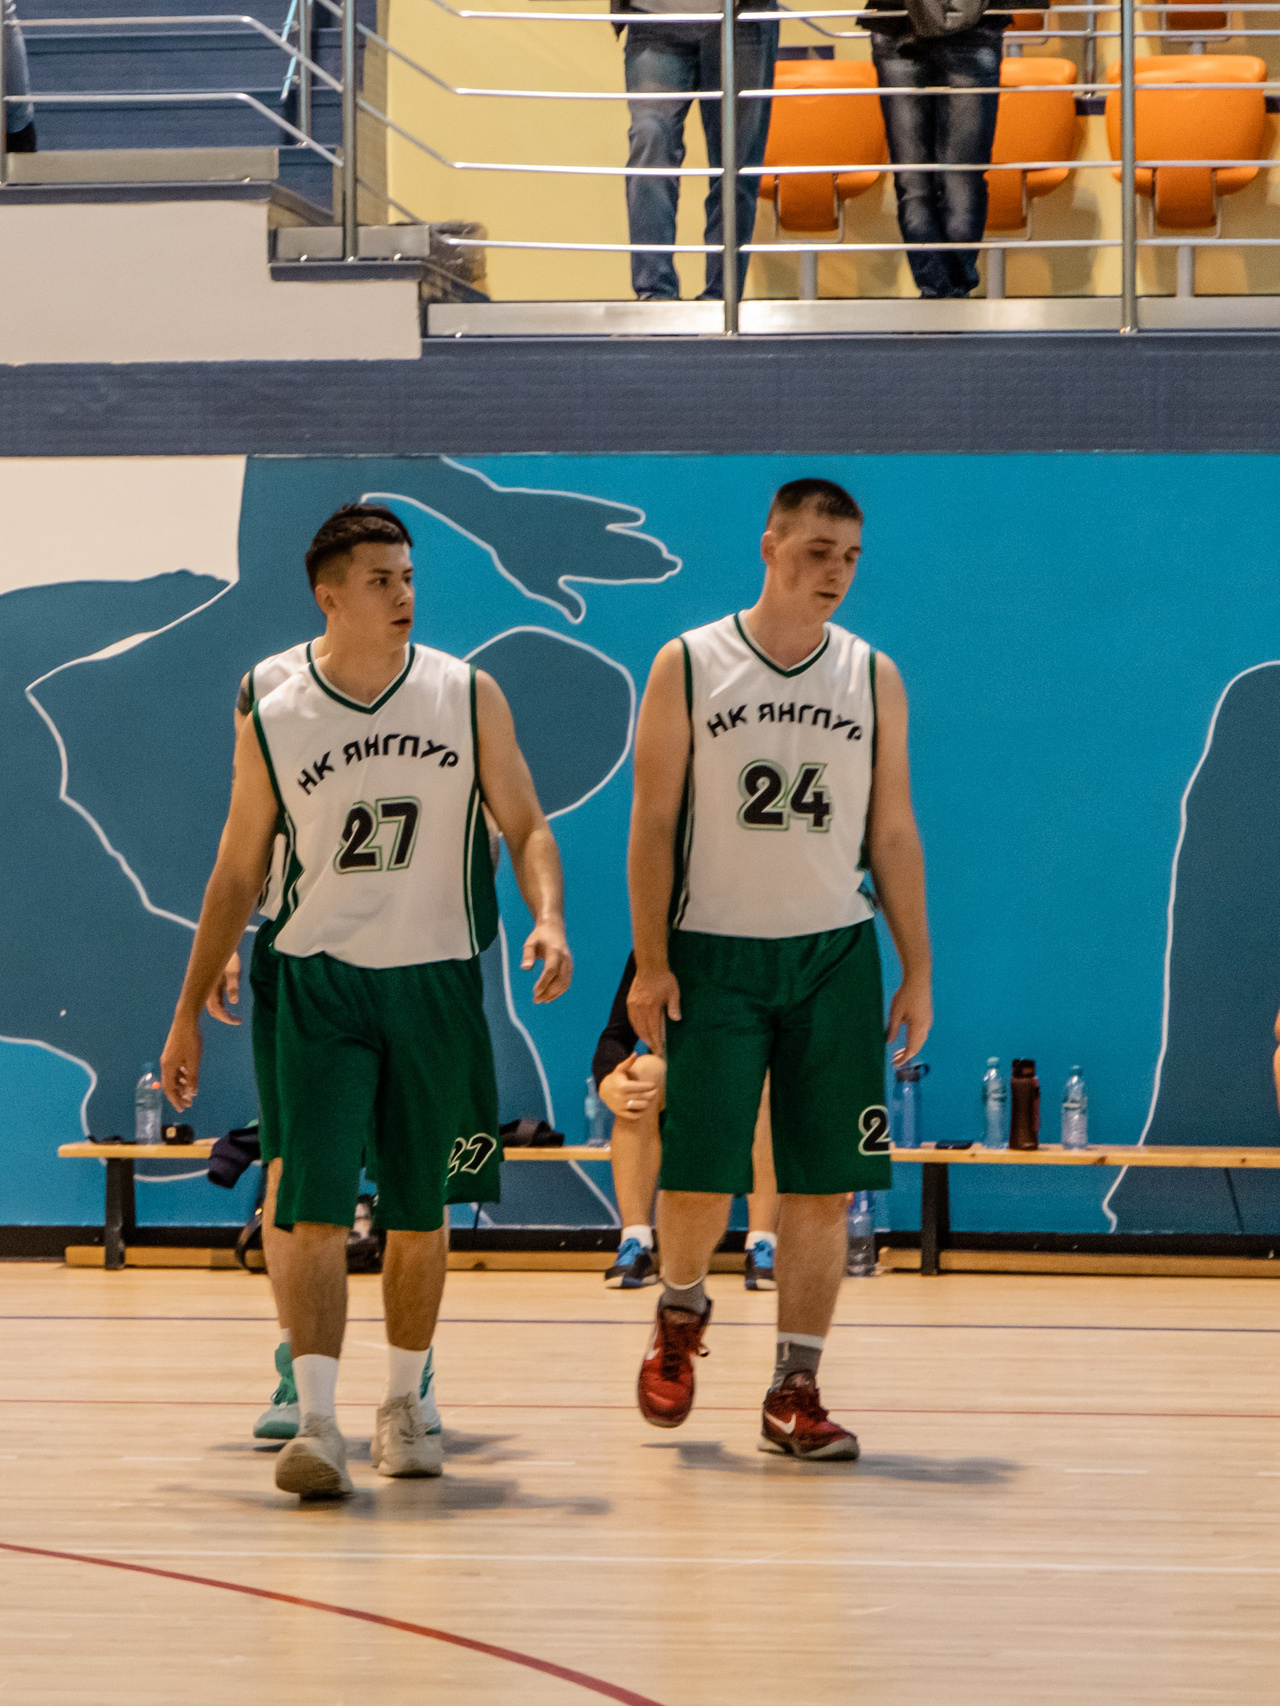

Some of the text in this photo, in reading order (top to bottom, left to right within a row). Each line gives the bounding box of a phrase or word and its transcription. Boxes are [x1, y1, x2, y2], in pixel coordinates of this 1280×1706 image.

[707, 702, 862, 741] НК ЯНГПУР
[297, 733, 459, 796] НК ЯНГПУР
[737, 758, 833, 834] 24
[333, 796, 422, 875] 27
